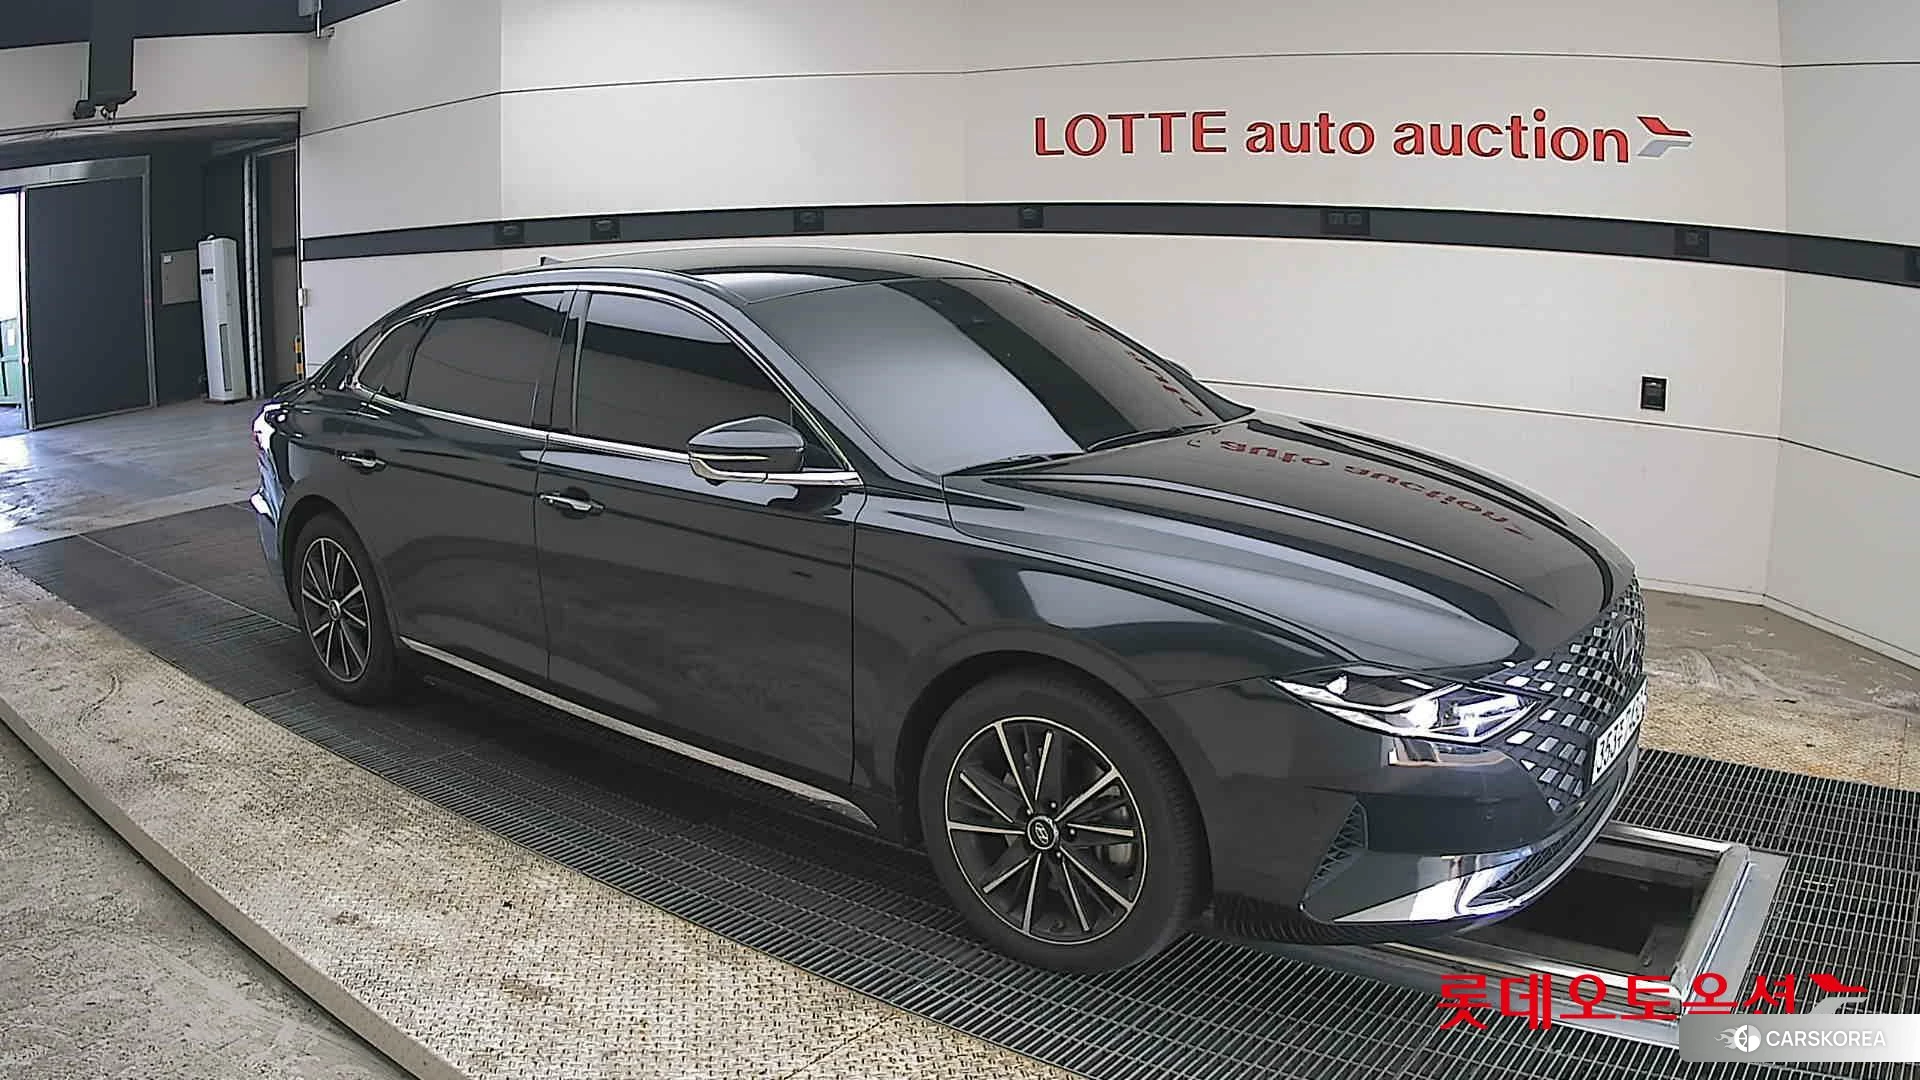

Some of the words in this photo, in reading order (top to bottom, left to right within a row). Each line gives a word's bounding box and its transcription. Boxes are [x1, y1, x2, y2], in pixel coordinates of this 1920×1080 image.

[1035, 110, 1227, 156] LOTTE
[1246, 112, 1375, 155] auto
[1392, 108, 1629, 163] auction
